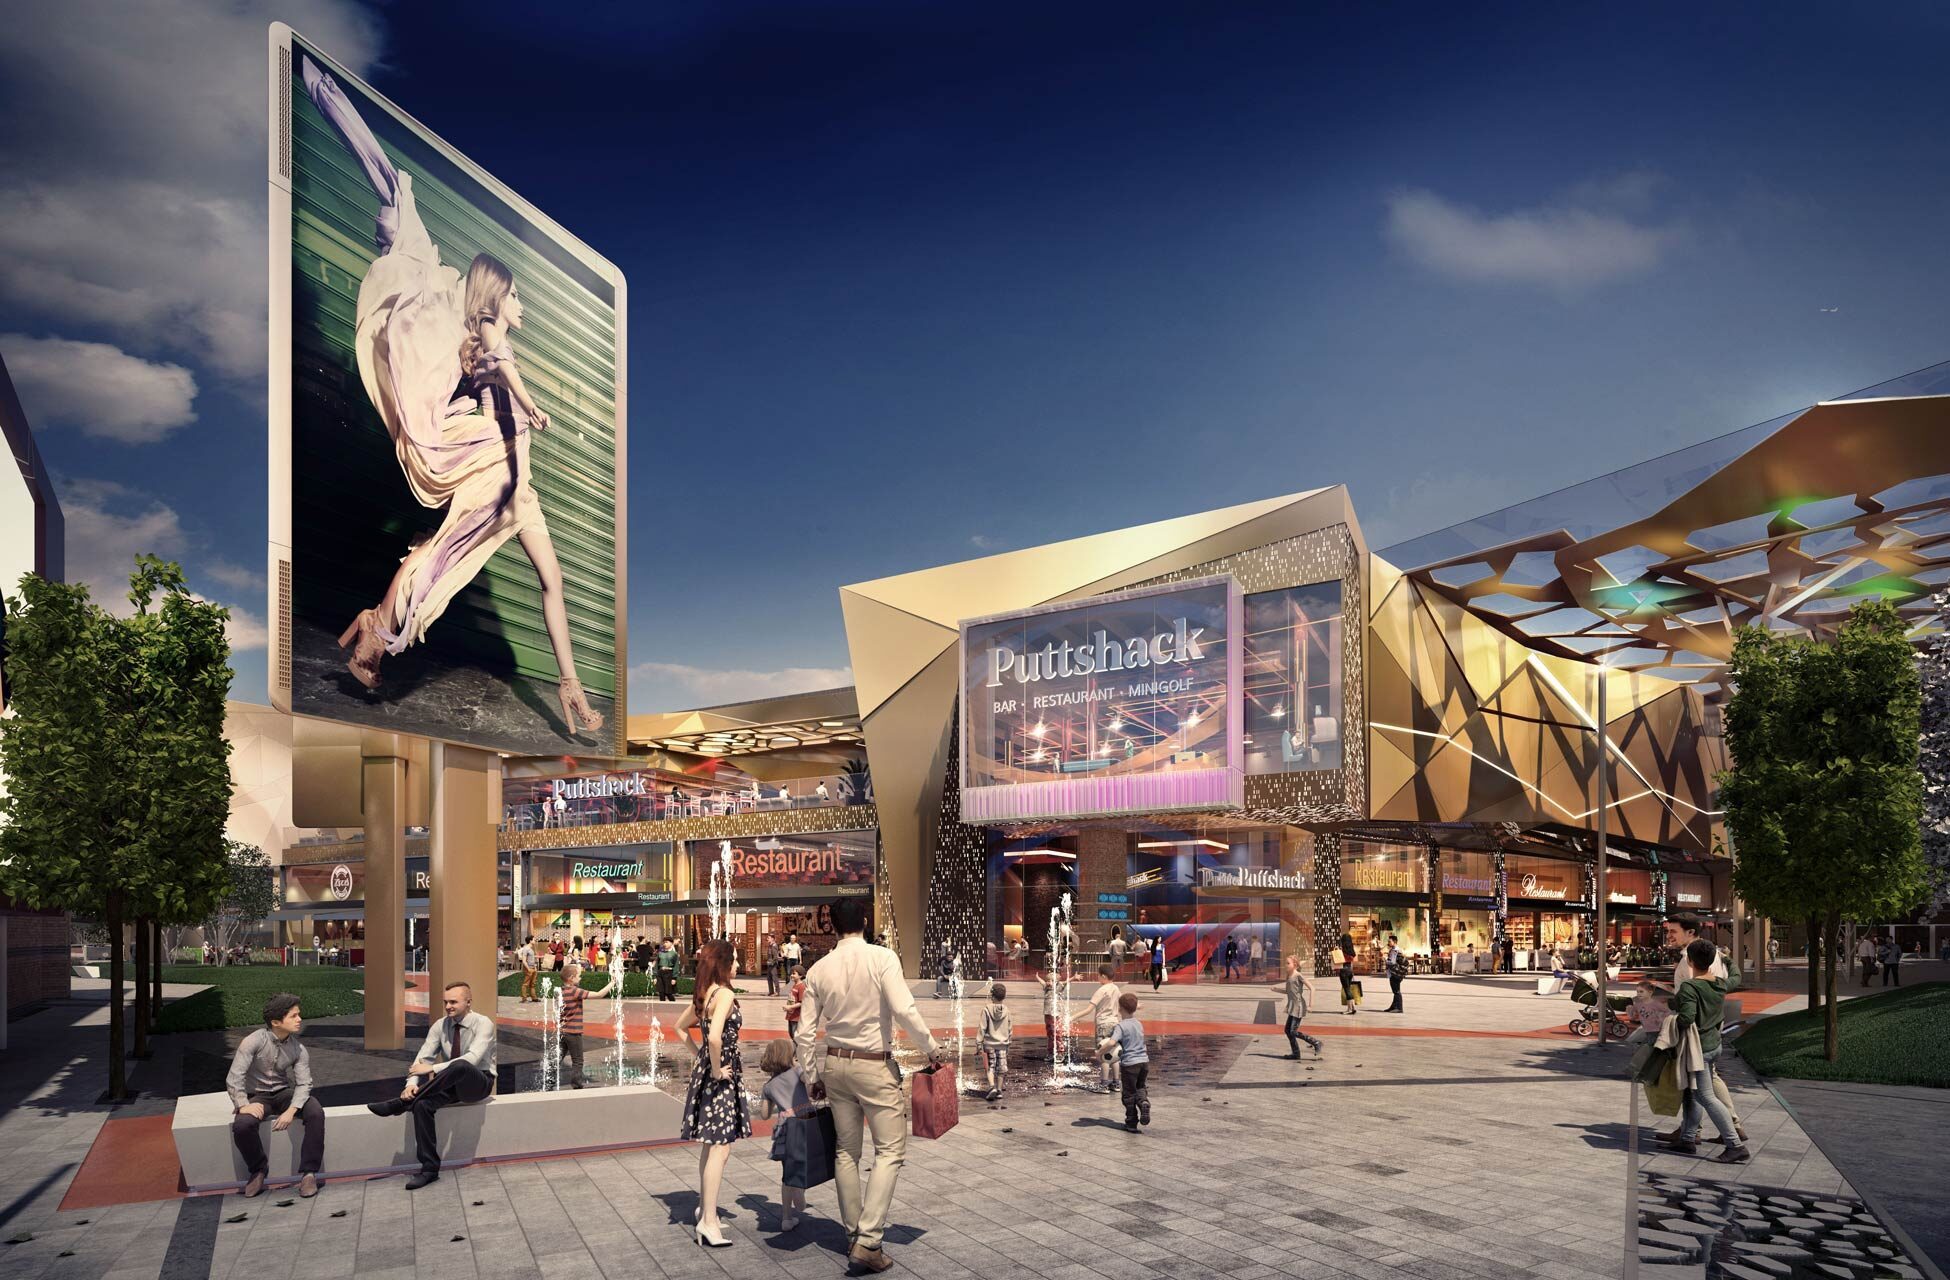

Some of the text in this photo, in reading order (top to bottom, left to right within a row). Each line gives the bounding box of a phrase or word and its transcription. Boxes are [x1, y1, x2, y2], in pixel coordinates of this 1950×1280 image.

[986, 616, 1205, 688] Puttshack
[993, 677, 1194, 714] BAR RESTAURANT MINIGOLF
[551, 772, 647, 800] Puttshack
[572, 860, 644, 879] Restaurant
[729, 844, 843, 875] Restaurant
[1355, 859, 1415, 888] Restaurant
[638, 892, 670, 900] Restaurant
[837, 886, 870, 895] Restaurant
[1520, 873, 1567, 899] Restaurant
[745, 915, 757, 972] Restaurant
